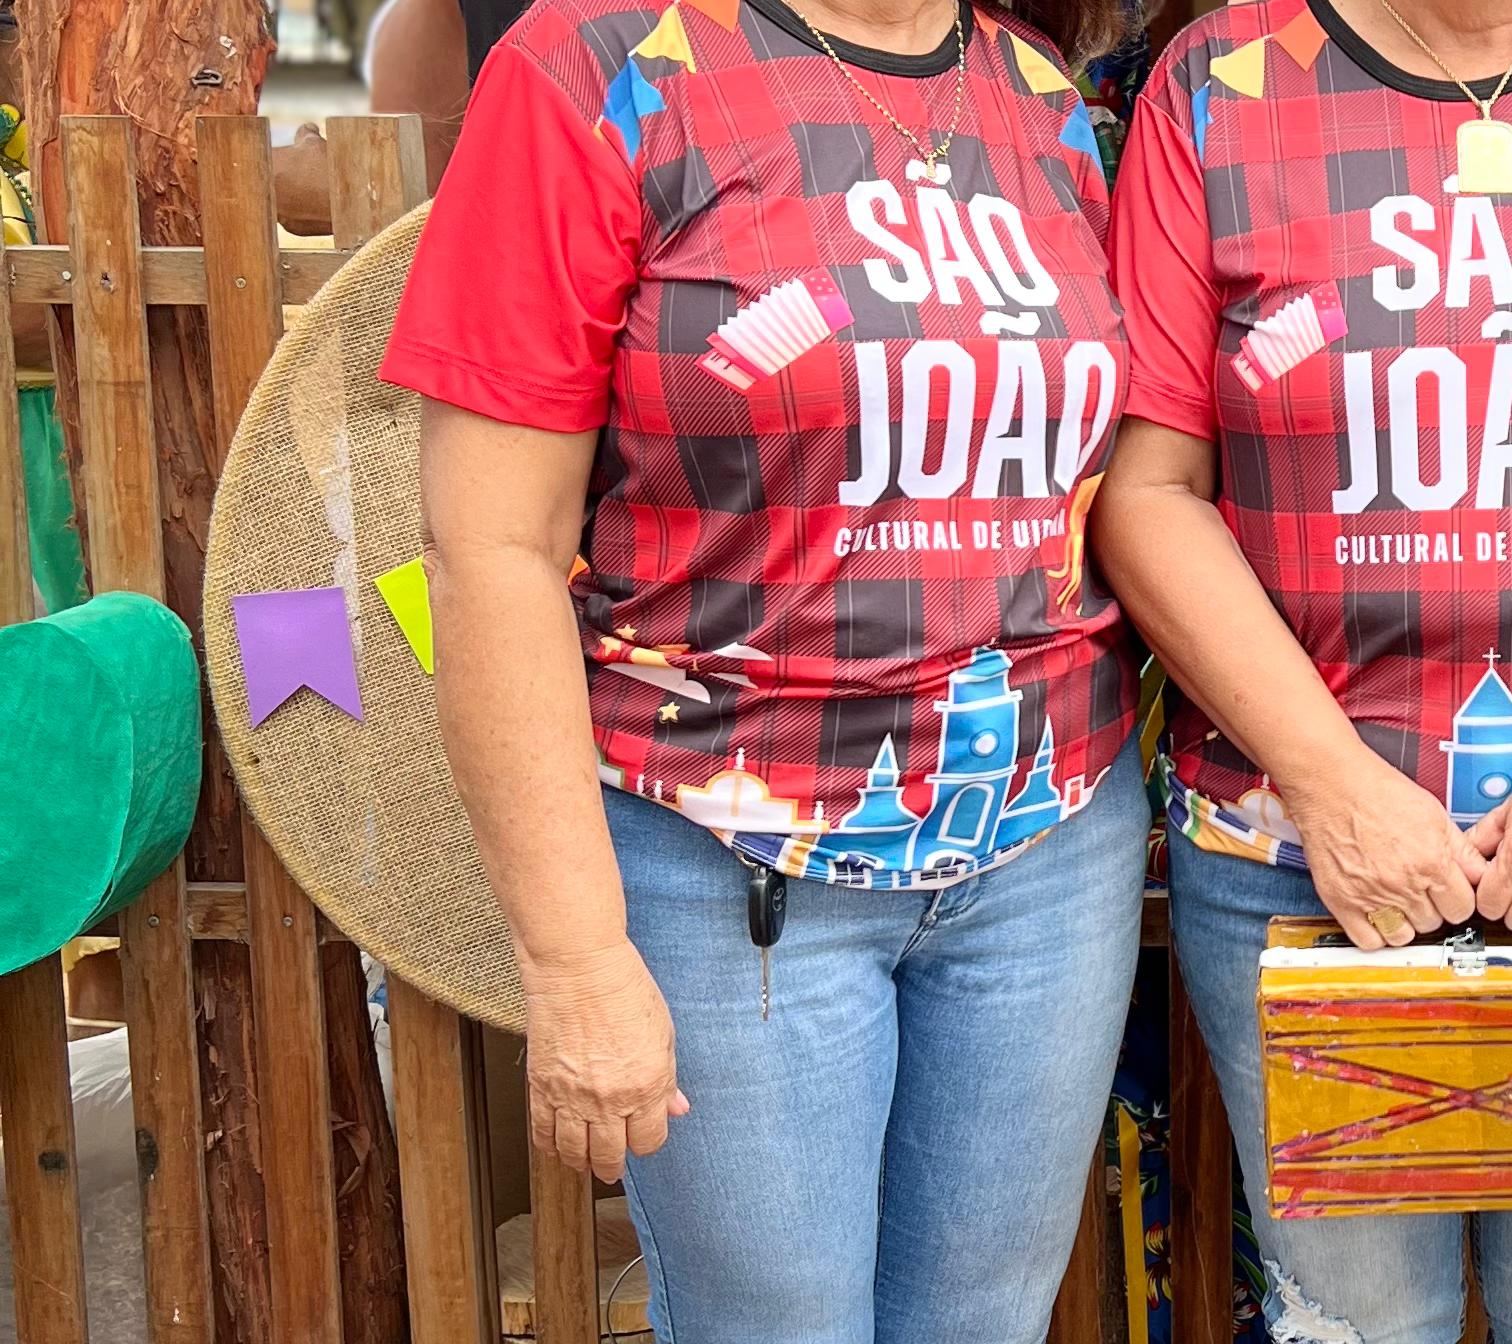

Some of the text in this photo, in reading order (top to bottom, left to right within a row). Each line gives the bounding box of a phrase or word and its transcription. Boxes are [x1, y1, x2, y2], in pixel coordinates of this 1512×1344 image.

[846, 159, 1060, 306] SÃO
[839, 308, 1116, 507] JOÃO
[833, 520, 963, 557] CULTURAL
[972, 520, 1002, 550] DE
[1335, 533, 1464, 565] CULTURAL
[1476, 532, 1507, 562] DE
